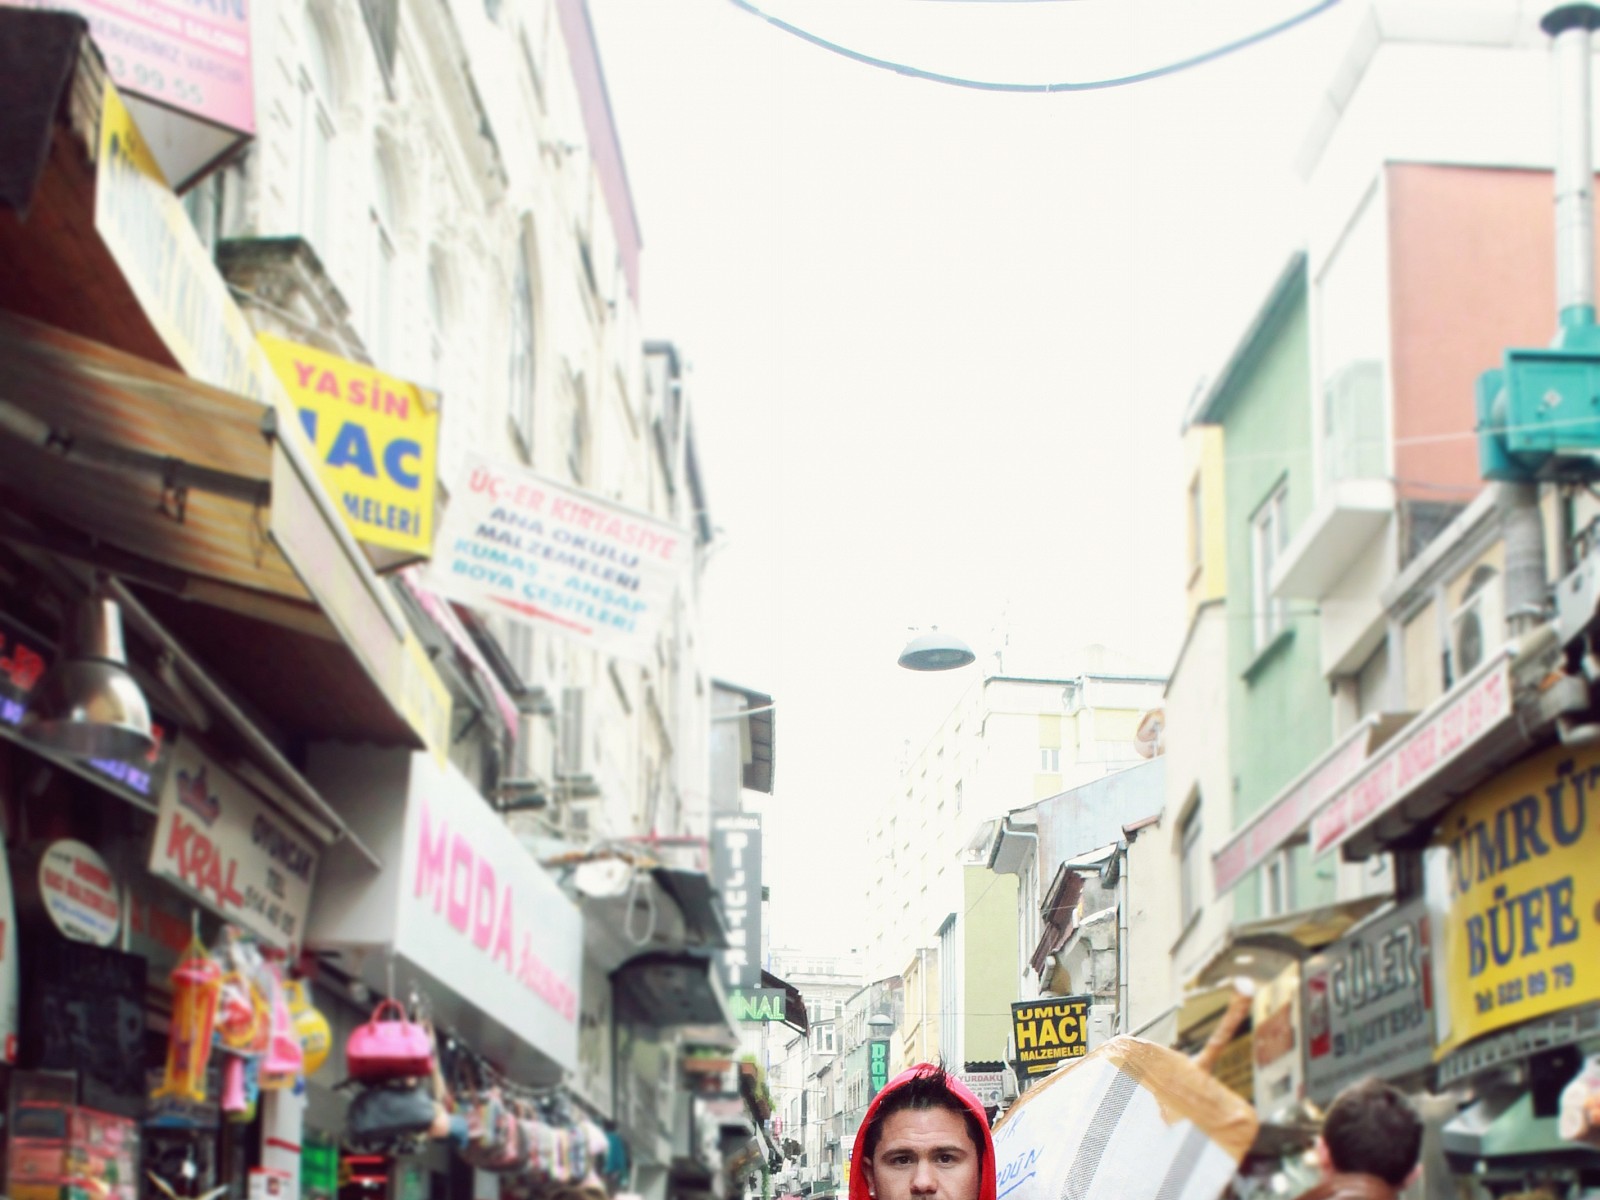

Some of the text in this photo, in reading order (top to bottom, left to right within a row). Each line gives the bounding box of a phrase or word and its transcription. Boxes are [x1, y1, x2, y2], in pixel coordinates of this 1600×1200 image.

[293, 358, 410, 421] YASİN
[451, 558, 516, 591] BOYA
[490, 506, 640, 569] ANA OKULU
[166, 811, 245, 909] KRAL
[1448, 757, 1600, 899] ÜMRÜ
[413, 797, 514, 974] MODA
[1465, 874, 1580, 980] BÜFE
[1017, 1003, 1087, 1020] UMUT
[1333, 922, 1421, 1018] GÜLER
